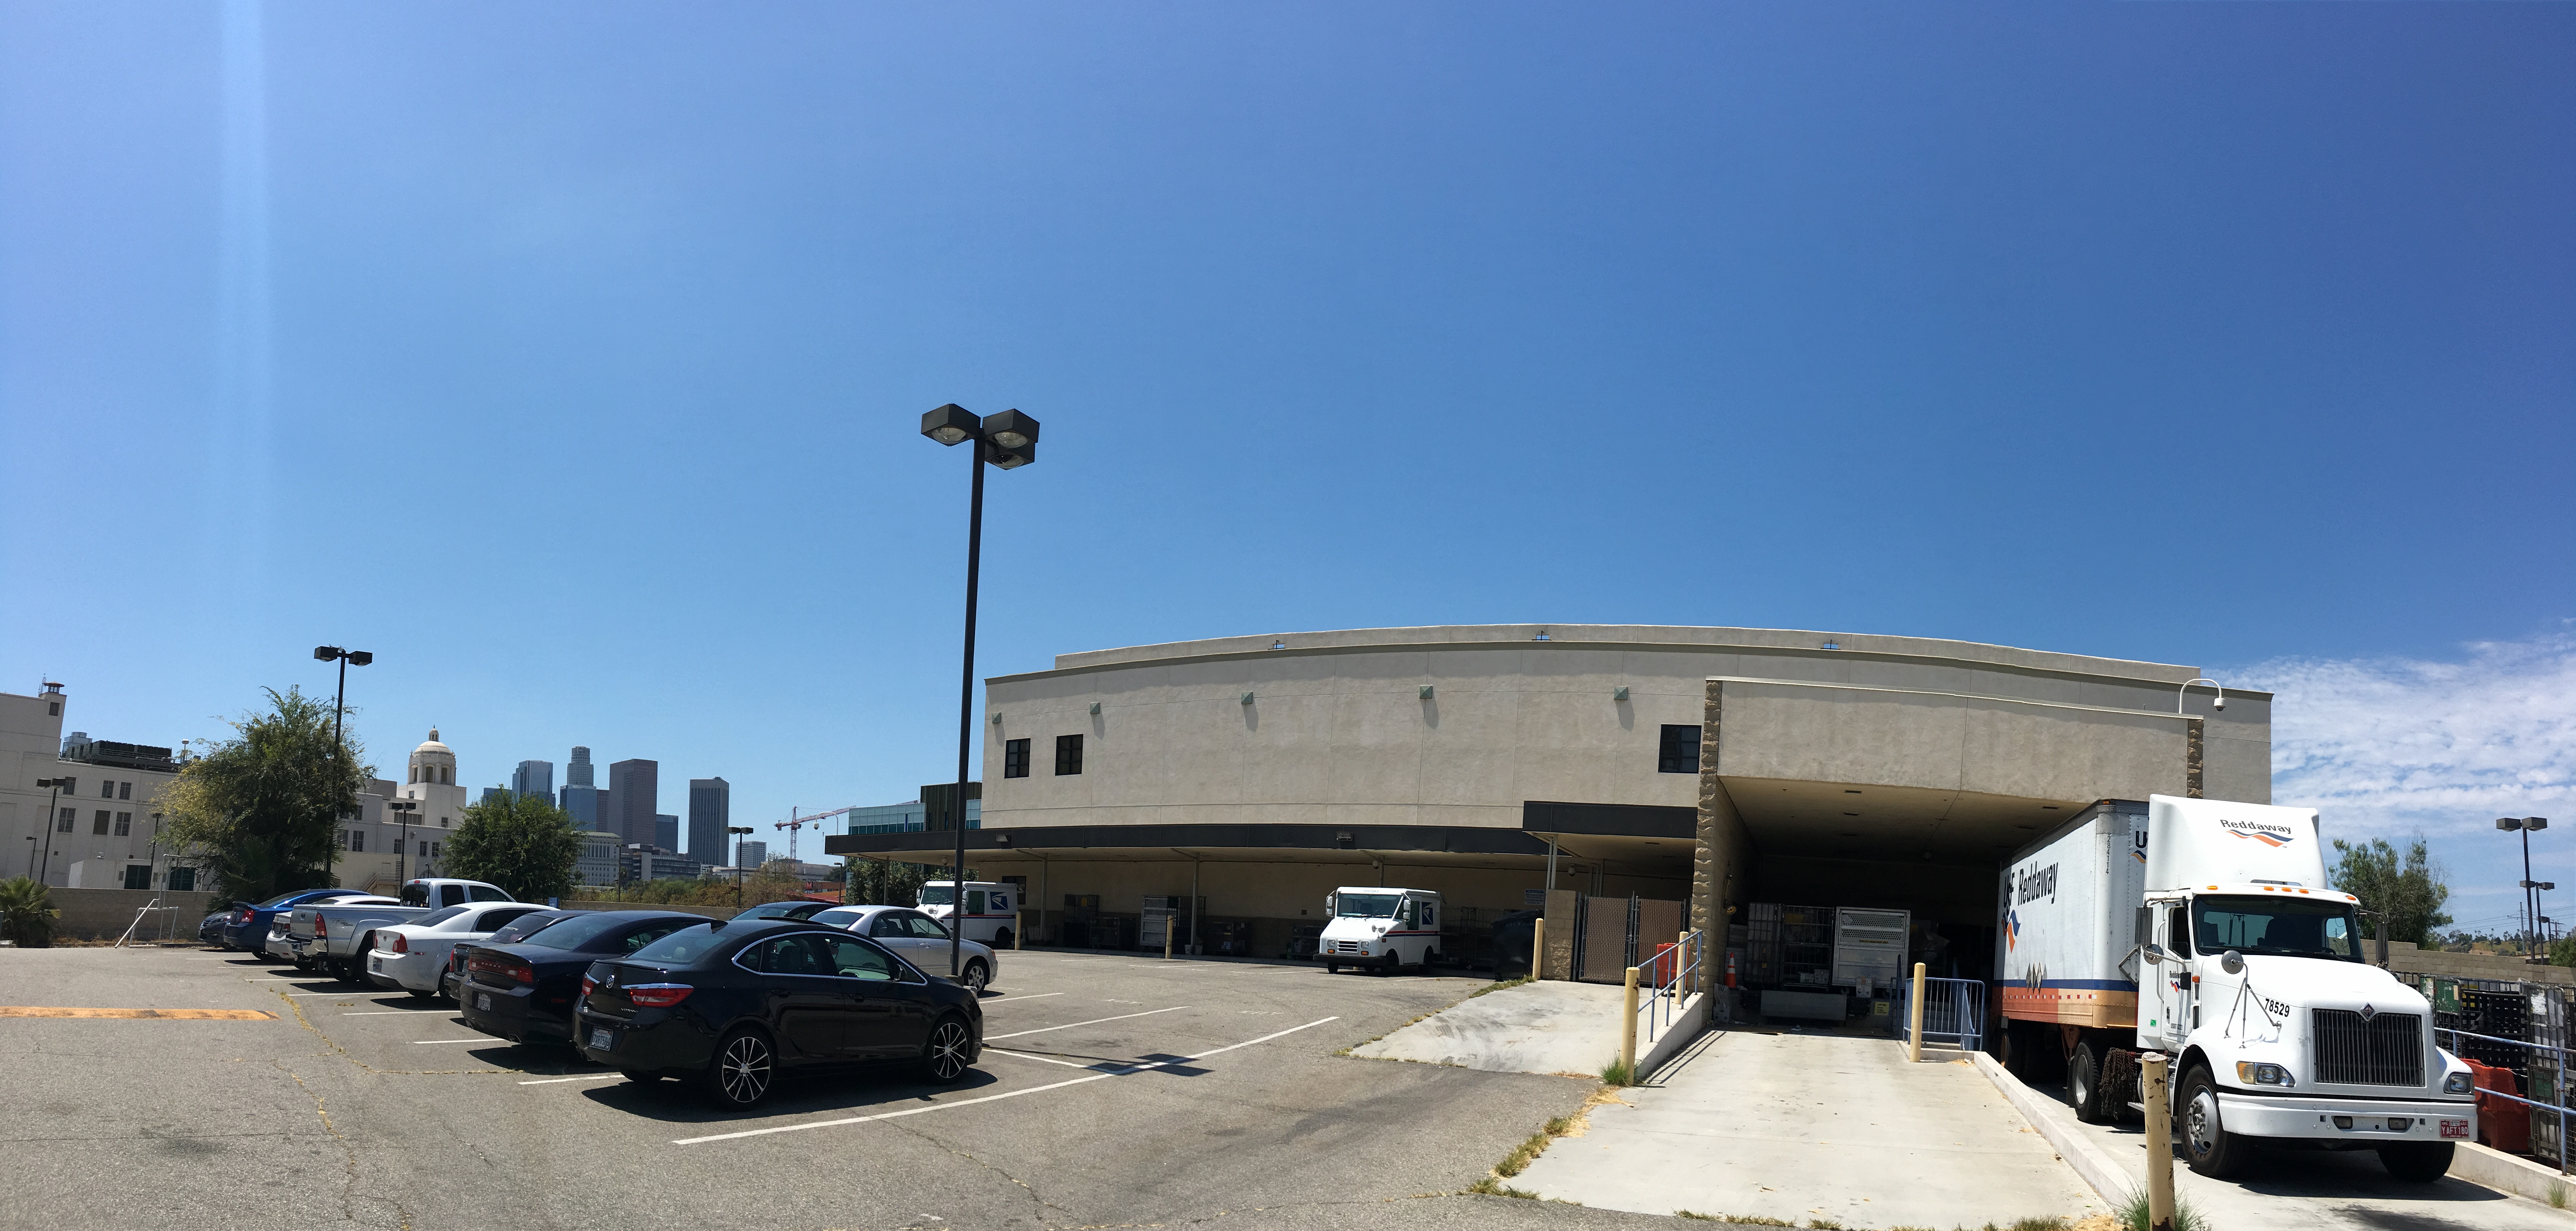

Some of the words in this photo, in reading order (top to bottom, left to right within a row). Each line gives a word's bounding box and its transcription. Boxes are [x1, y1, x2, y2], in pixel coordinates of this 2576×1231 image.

[2220, 819, 2291, 834] Reddaway
[2018, 861, 2059, 906] Reddaway
[2265, 998, 2290, 1018] 78529
[593, 1034, 611, 1046] 7XRT586
